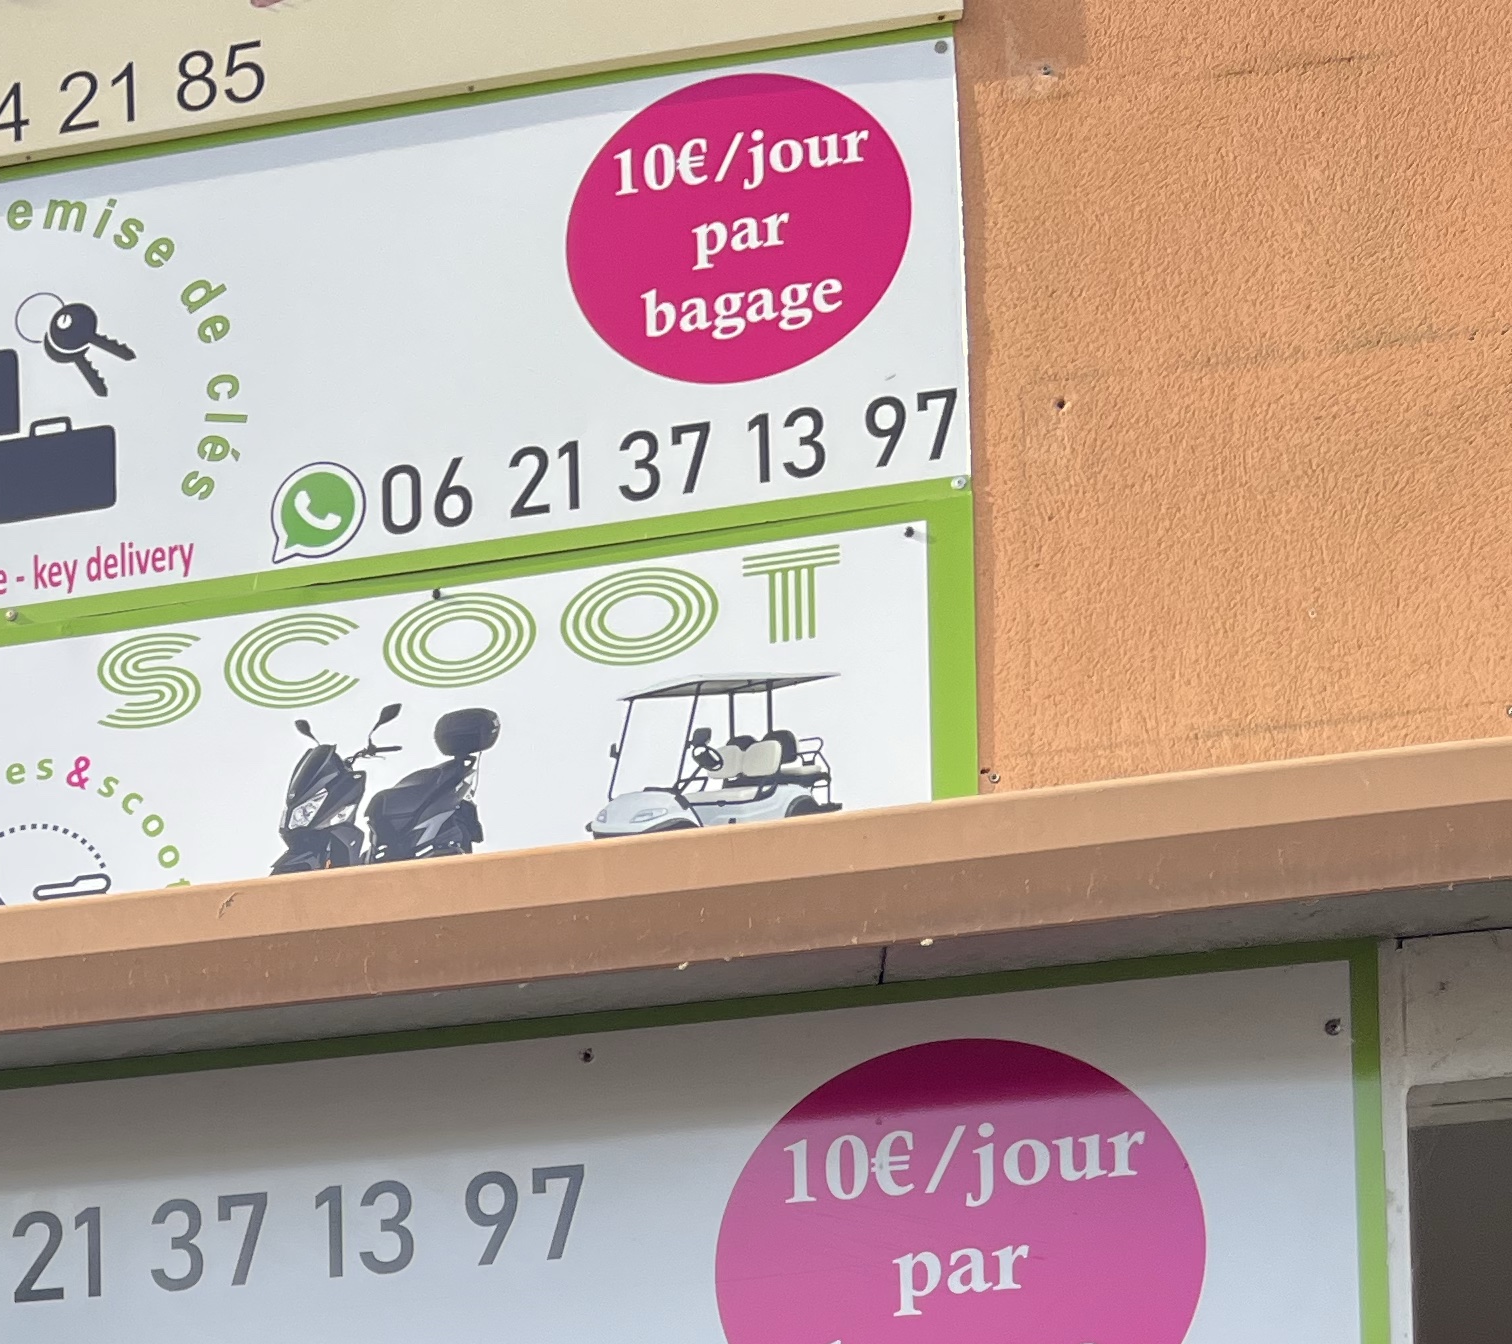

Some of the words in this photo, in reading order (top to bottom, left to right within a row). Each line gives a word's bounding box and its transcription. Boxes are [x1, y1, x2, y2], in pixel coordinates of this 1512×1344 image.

[59, 62, 137, 136] 21
[177, 40, 265, 113] 85
[612, 124, 870, 196] 10€/jour
[690, 206, 791, 272] par
[180, 278, 231, 344] de
[640, 273, 843, 340] bagage
[181, 373, 249, 501] clés
[380, 455, 474, 537] 06
[508, 439, 580, 519] 21
[617, 420, 712, 503] 37
[746, 405, 826, 483] 13
[862, 387, 958, 468] 97
[33, 554, 79, 594] key
[87, 541, 195, 583] delivery
[96, 543, 842, 731] SCOOT
[783, 1121, 1146, 1208] 10€/jour
[12, 1207, 102, 1303] 21
[149, 1191, 270, 1292] 37
[314, 1179, 415, 1279] 13
[464, 1164, 586, 1267] 97
[893, 1243, 1029, 1318] par
